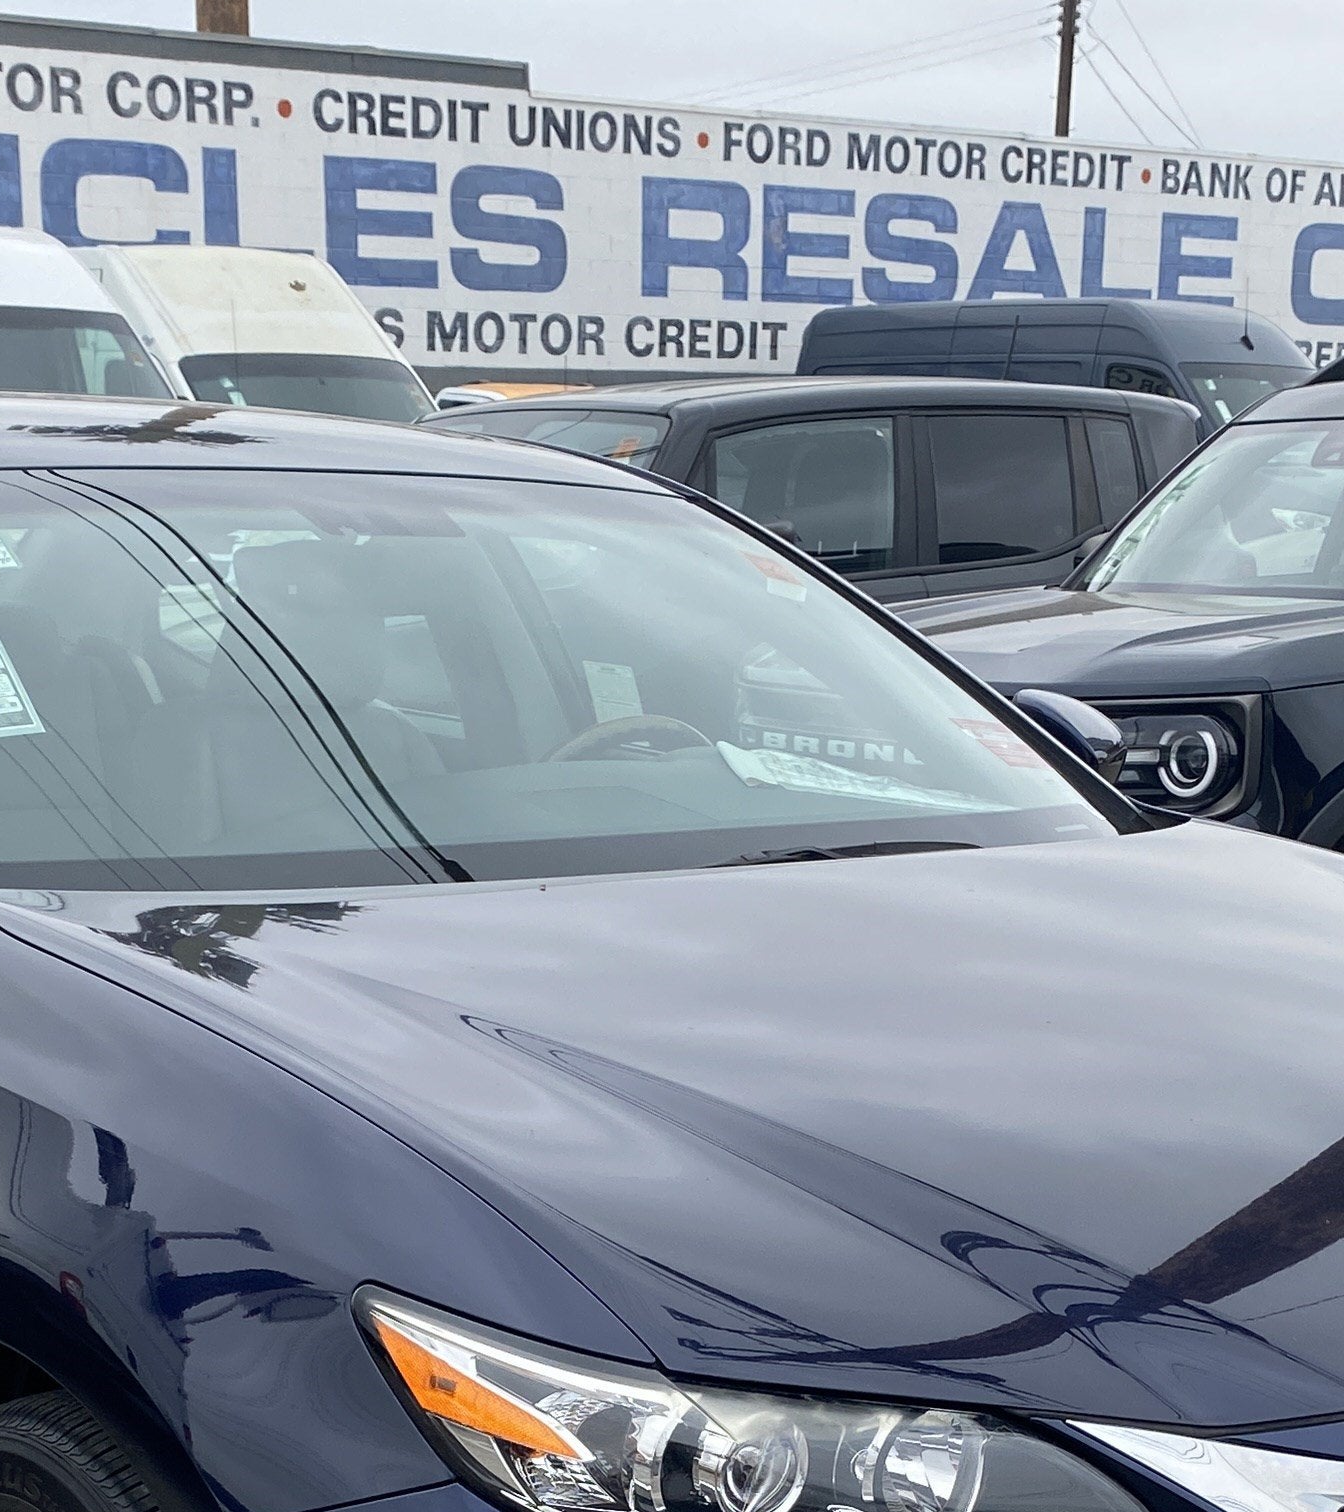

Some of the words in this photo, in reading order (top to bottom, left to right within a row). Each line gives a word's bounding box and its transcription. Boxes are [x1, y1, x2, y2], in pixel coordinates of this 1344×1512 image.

[106, 70, 260, 128] CORP.
[312, 87, 489, 144] CREDIT
[508, 104, 682, 158] UNIONS
[723, 122, 831, 168] FORD
[847, 133, 987, 181] MOTOR
[1001, 146, 1132, 191] CREDIT
[1161, 157, 1252, 201] BANK
[1265, 167, 1308, 203] OF
[641, 176, 1239, 306] RESALE
[426, 310, 605, 356] MOTOR
[625, 317, 787, 360] CREDIT
[762, 731, 924, 765] BRON
